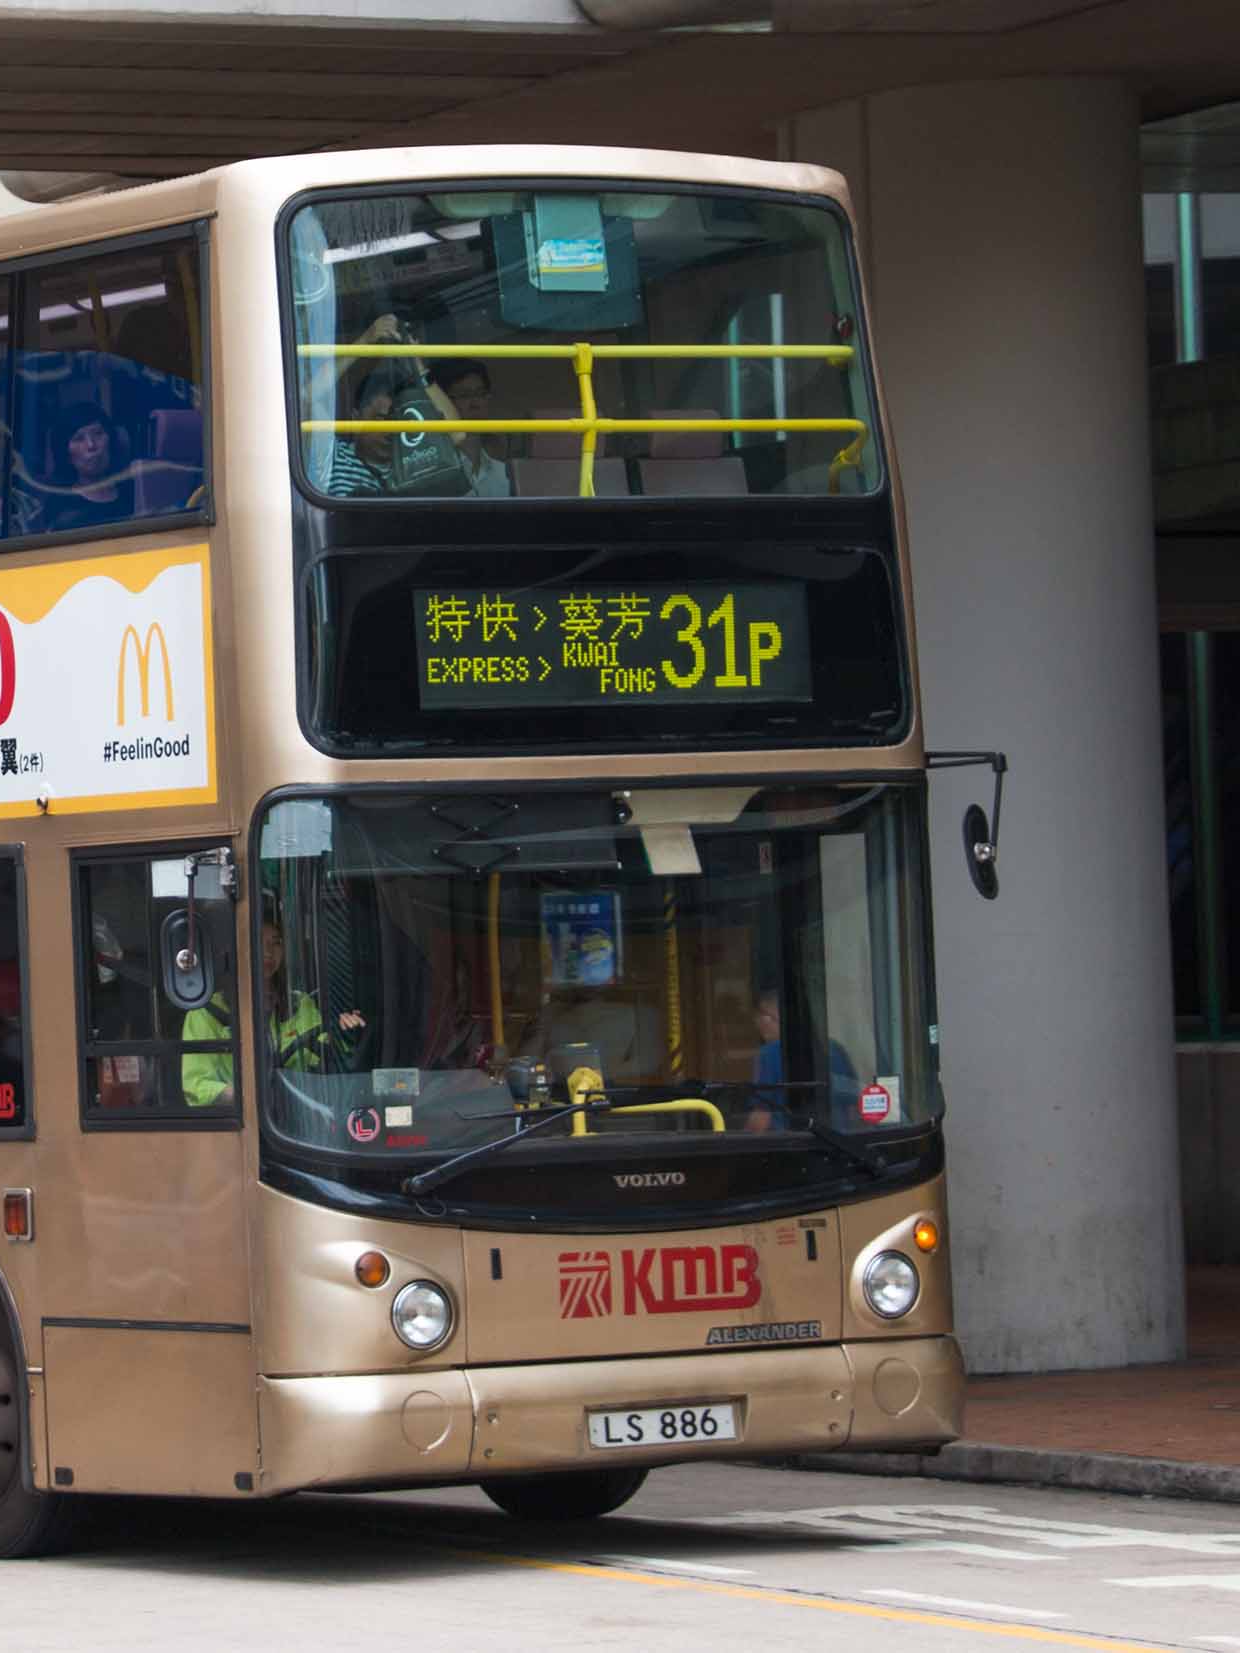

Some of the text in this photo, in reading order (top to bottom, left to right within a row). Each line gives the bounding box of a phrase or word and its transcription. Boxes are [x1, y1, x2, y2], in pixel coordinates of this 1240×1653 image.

[425, 592, 651, 642] 特快 葵芳
[562, 641, 620, 667] KWAI
[659, 593, 783, 688] 31P
[427, 657, 530, 683] EXPRESS
[600, 668, 656, 693] FONG
[103, 734, 191, 762] #FeelinGood
[613, 1171, 686, 1188] VOLVO
[620, 1244, 763, 1316] KMB
[707, 1321, 822, 1345] ALEXANDER
[604, 1408, 718, 1443] LS 886
